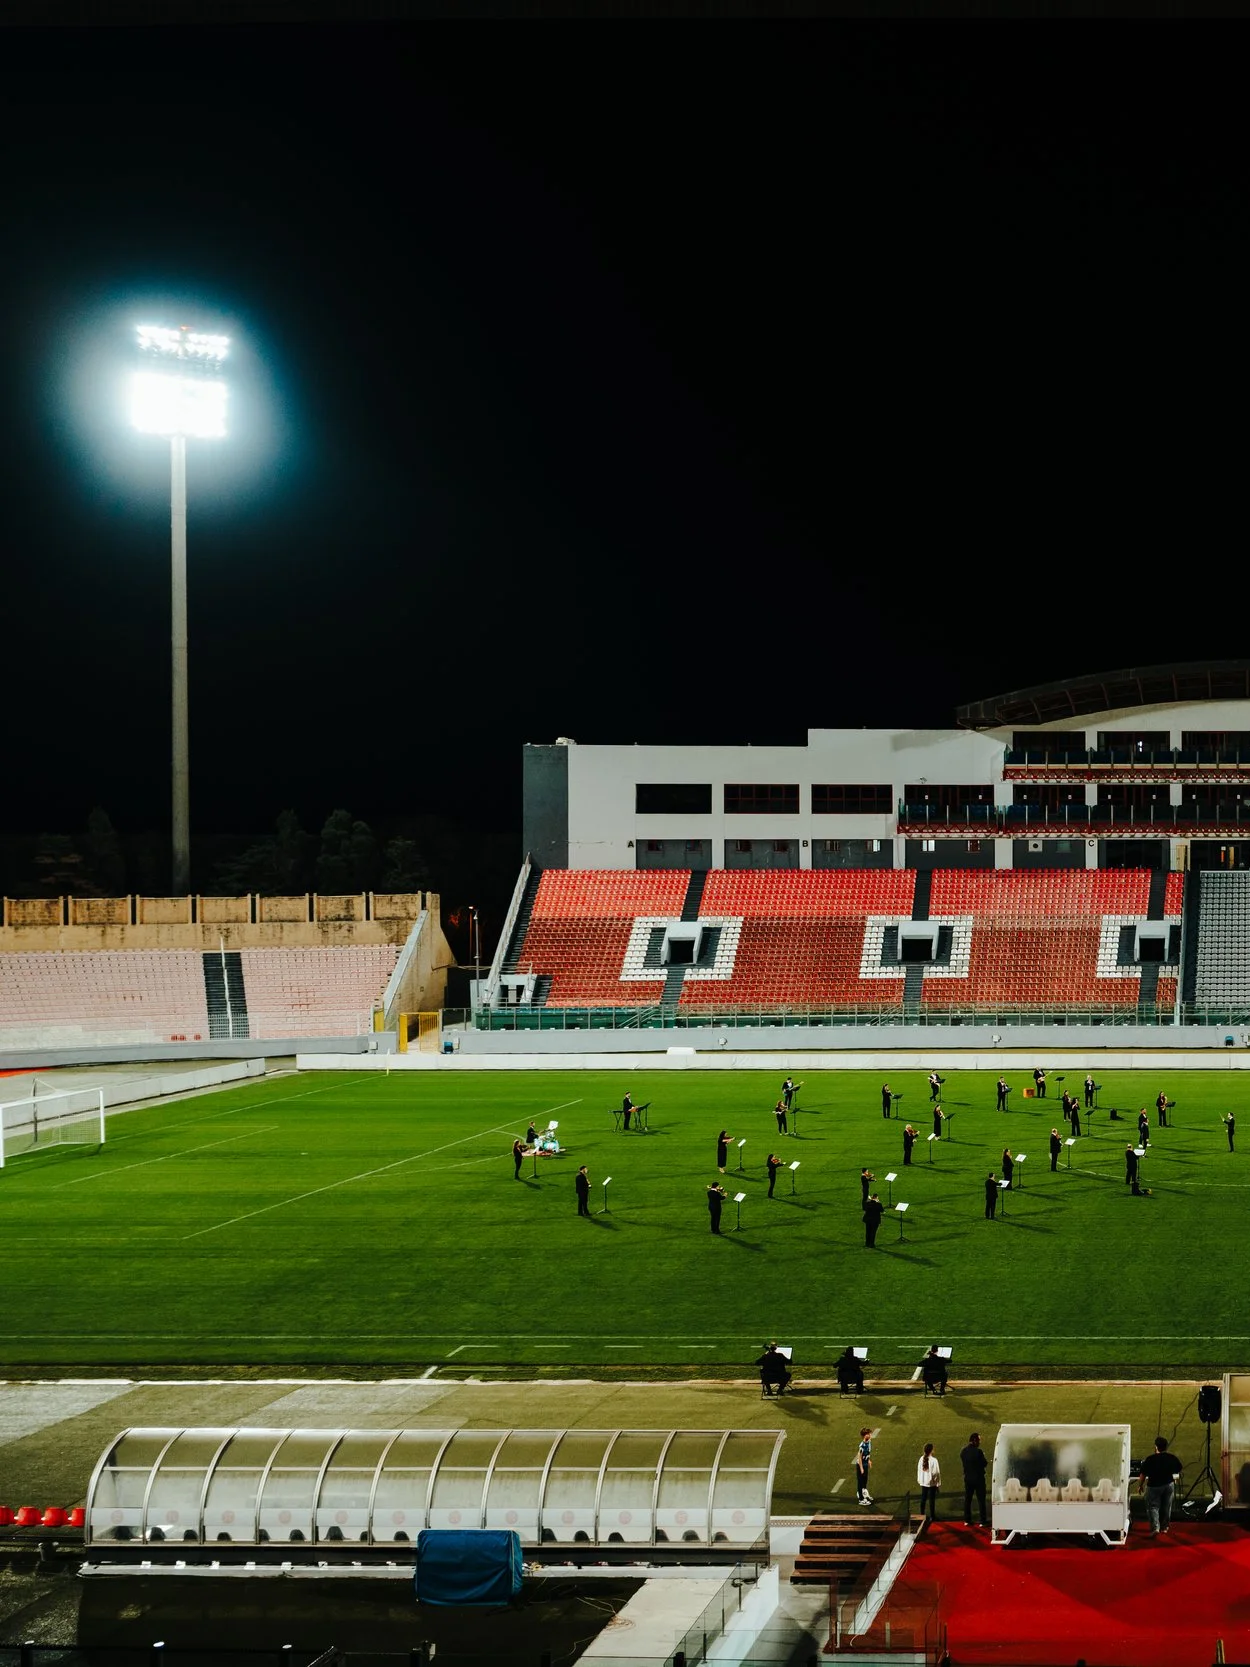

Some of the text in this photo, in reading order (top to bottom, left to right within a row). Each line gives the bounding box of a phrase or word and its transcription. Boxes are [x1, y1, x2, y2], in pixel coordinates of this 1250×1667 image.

[627, 839, 635, 848] A
[801, 839, 809, 848] B
[1087, 839, 1095, 848] C
